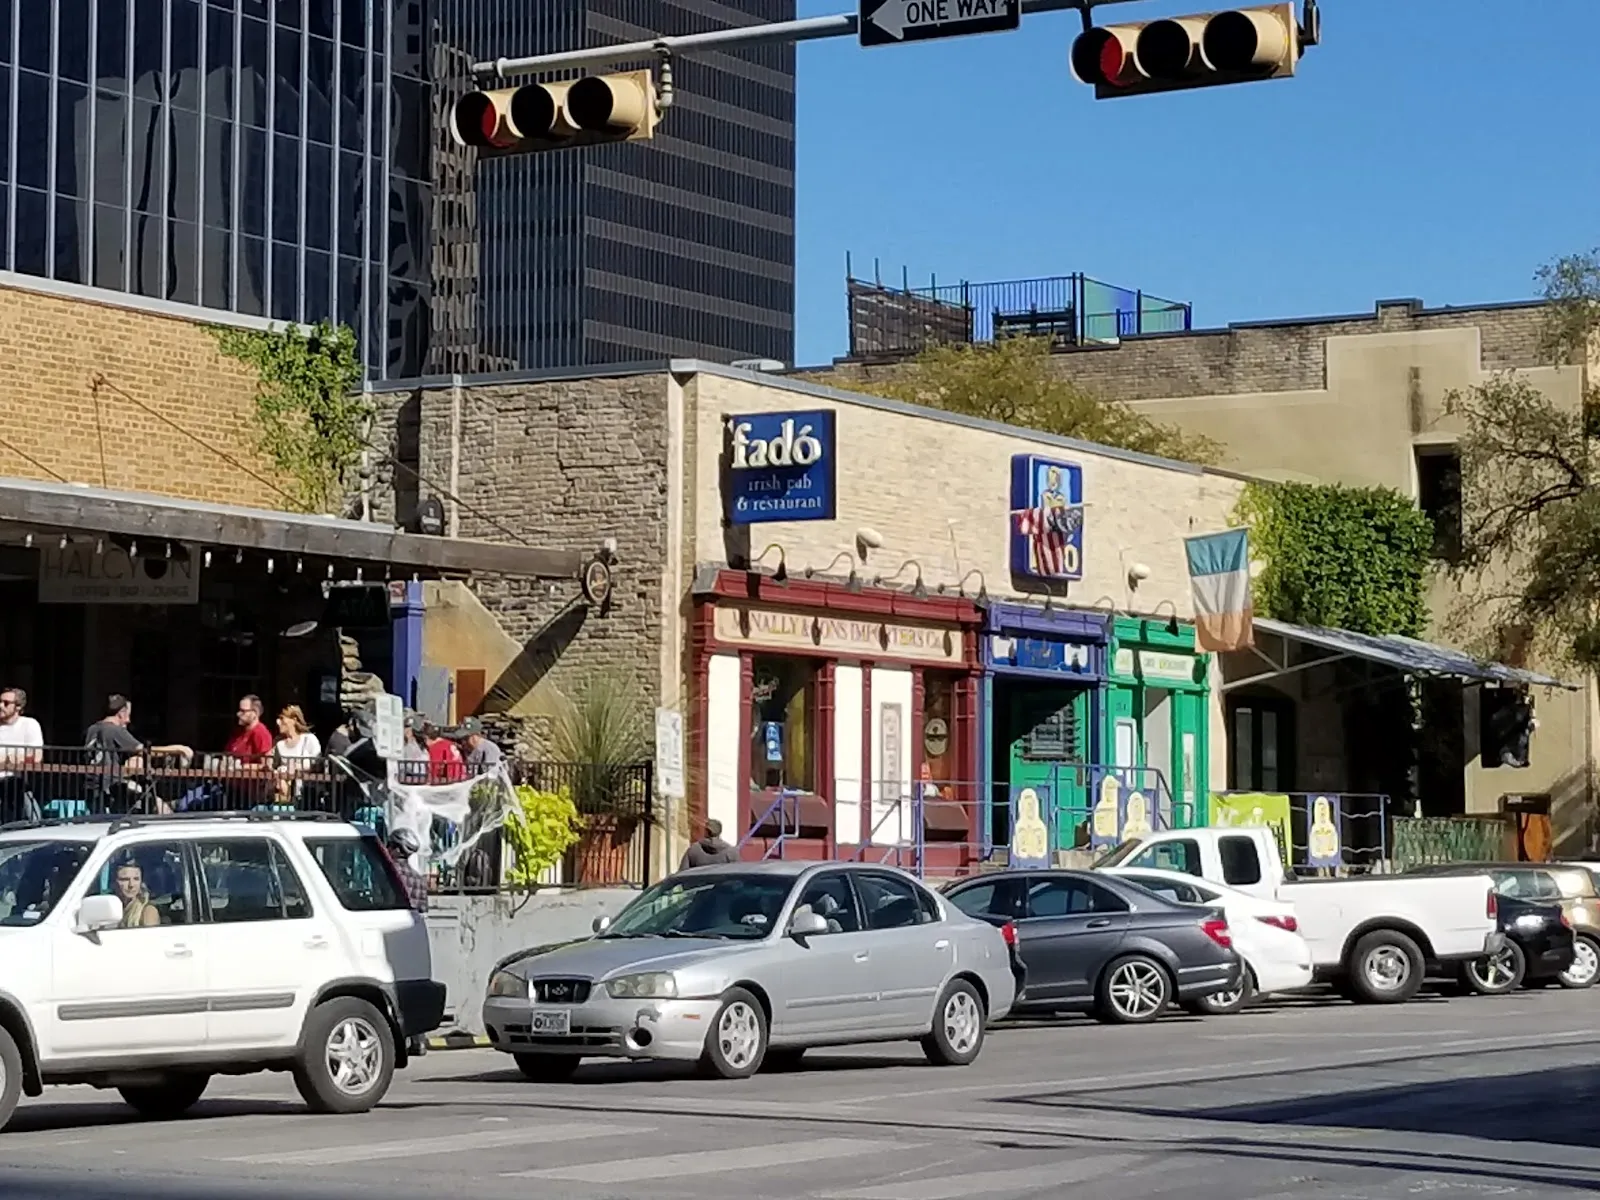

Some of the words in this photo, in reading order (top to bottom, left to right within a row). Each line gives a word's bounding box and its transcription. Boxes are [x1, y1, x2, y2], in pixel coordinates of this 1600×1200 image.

[906, 0, 949, 24] ONE
[955, 0, 998, 18] WAY
[731, 418, 822, 469] fadó
[748, 473, 781, 491] irish
[787, 473, 812, 495] pub
[736, 496, 748, 511] &
[752, 496, 822, 511] restaurant
